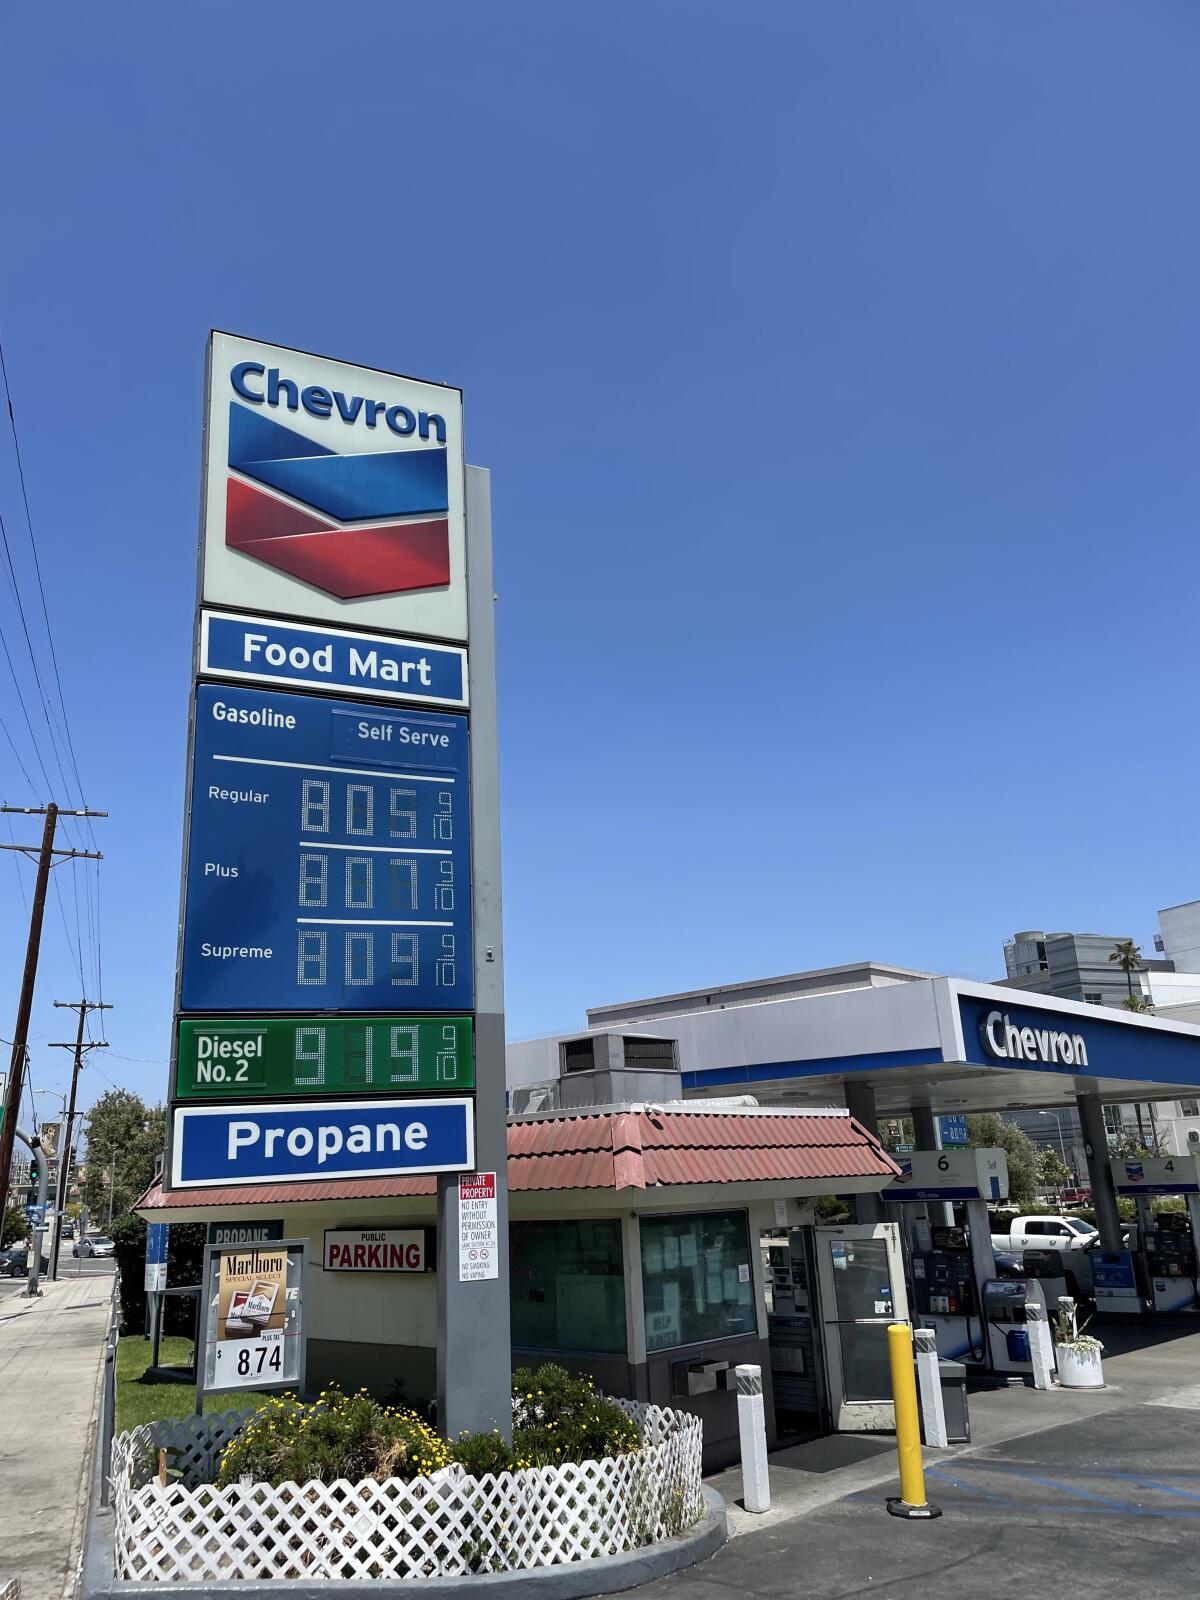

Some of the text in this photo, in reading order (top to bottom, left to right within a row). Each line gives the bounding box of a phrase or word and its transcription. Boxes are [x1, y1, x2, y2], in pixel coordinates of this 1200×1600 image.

[230, 361, 447, 442] Chevron
[243, 633, 432, 685] Food Mart
[213, 701, 296, 729] Gasoline
[358, 722, 450, 747] Self Serve
[208, 786, 269, 804] Regular
[205, 863, 239, 878] Plus
[201, 943, 273, 960] Supreme
[983, 1011, 1088, 1066] Chevron
[197, 1035, 262, 1059] Diesel
[197, 1060, 249, 1083] No. 2
[227, 1121, 428, 1164] Propane
[937, 1155, 949, 1171] 6
[1165, 1160, 1175, 1172] 4
[461, 1175, 486, 1186] PRIVATE
[461, 1187, 493, 1199] PROPERTY
[461, 1200, 488, 1210] NO ENTRY
[461, 1211, 487, 1220] WITHOUT
[461, 1221, 495, 1231] PERMISSION
[216, 1229, 269, 1244] PROPANE
[361, 1233, 386, 1242] PUBLIC
[462, 1231, 491, 1241] OF OWNER
[226, 1250, 282, 1276] Marlboro
[328, 1244, 420, 1269] PARKING
[461, 1261, 490, 1271] NO SMOKING
[225, 1275, 253, 1283] SPECIAL
[469, 1271, 486, 1279] VAPING
